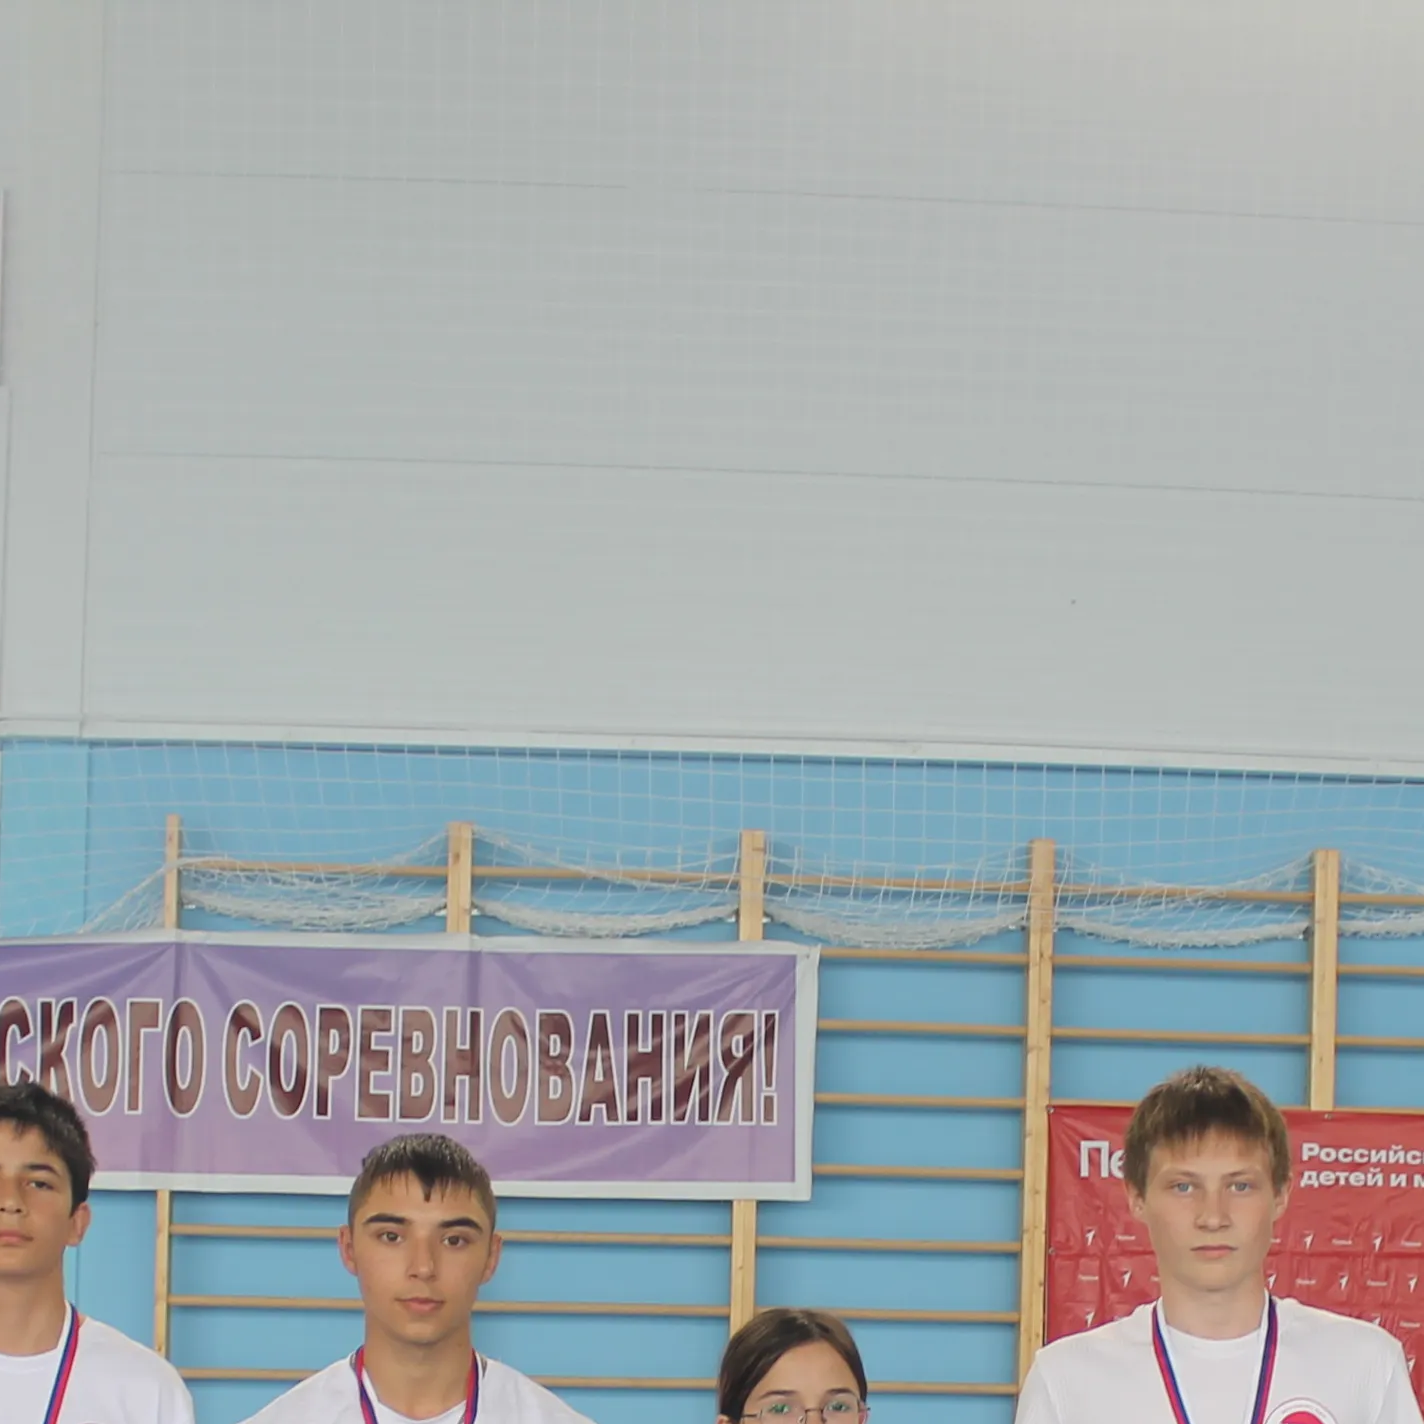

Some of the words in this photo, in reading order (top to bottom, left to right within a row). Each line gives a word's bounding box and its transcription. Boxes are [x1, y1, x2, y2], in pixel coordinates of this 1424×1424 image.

[221, 999, 779, 1126] СОРЕВНОВАНИЯ!
[1080, 1140, 1124, 1178] Пе
[1300, 1168, 1384, 1188] детей
[1390, 1174, 1407, 1187] и
